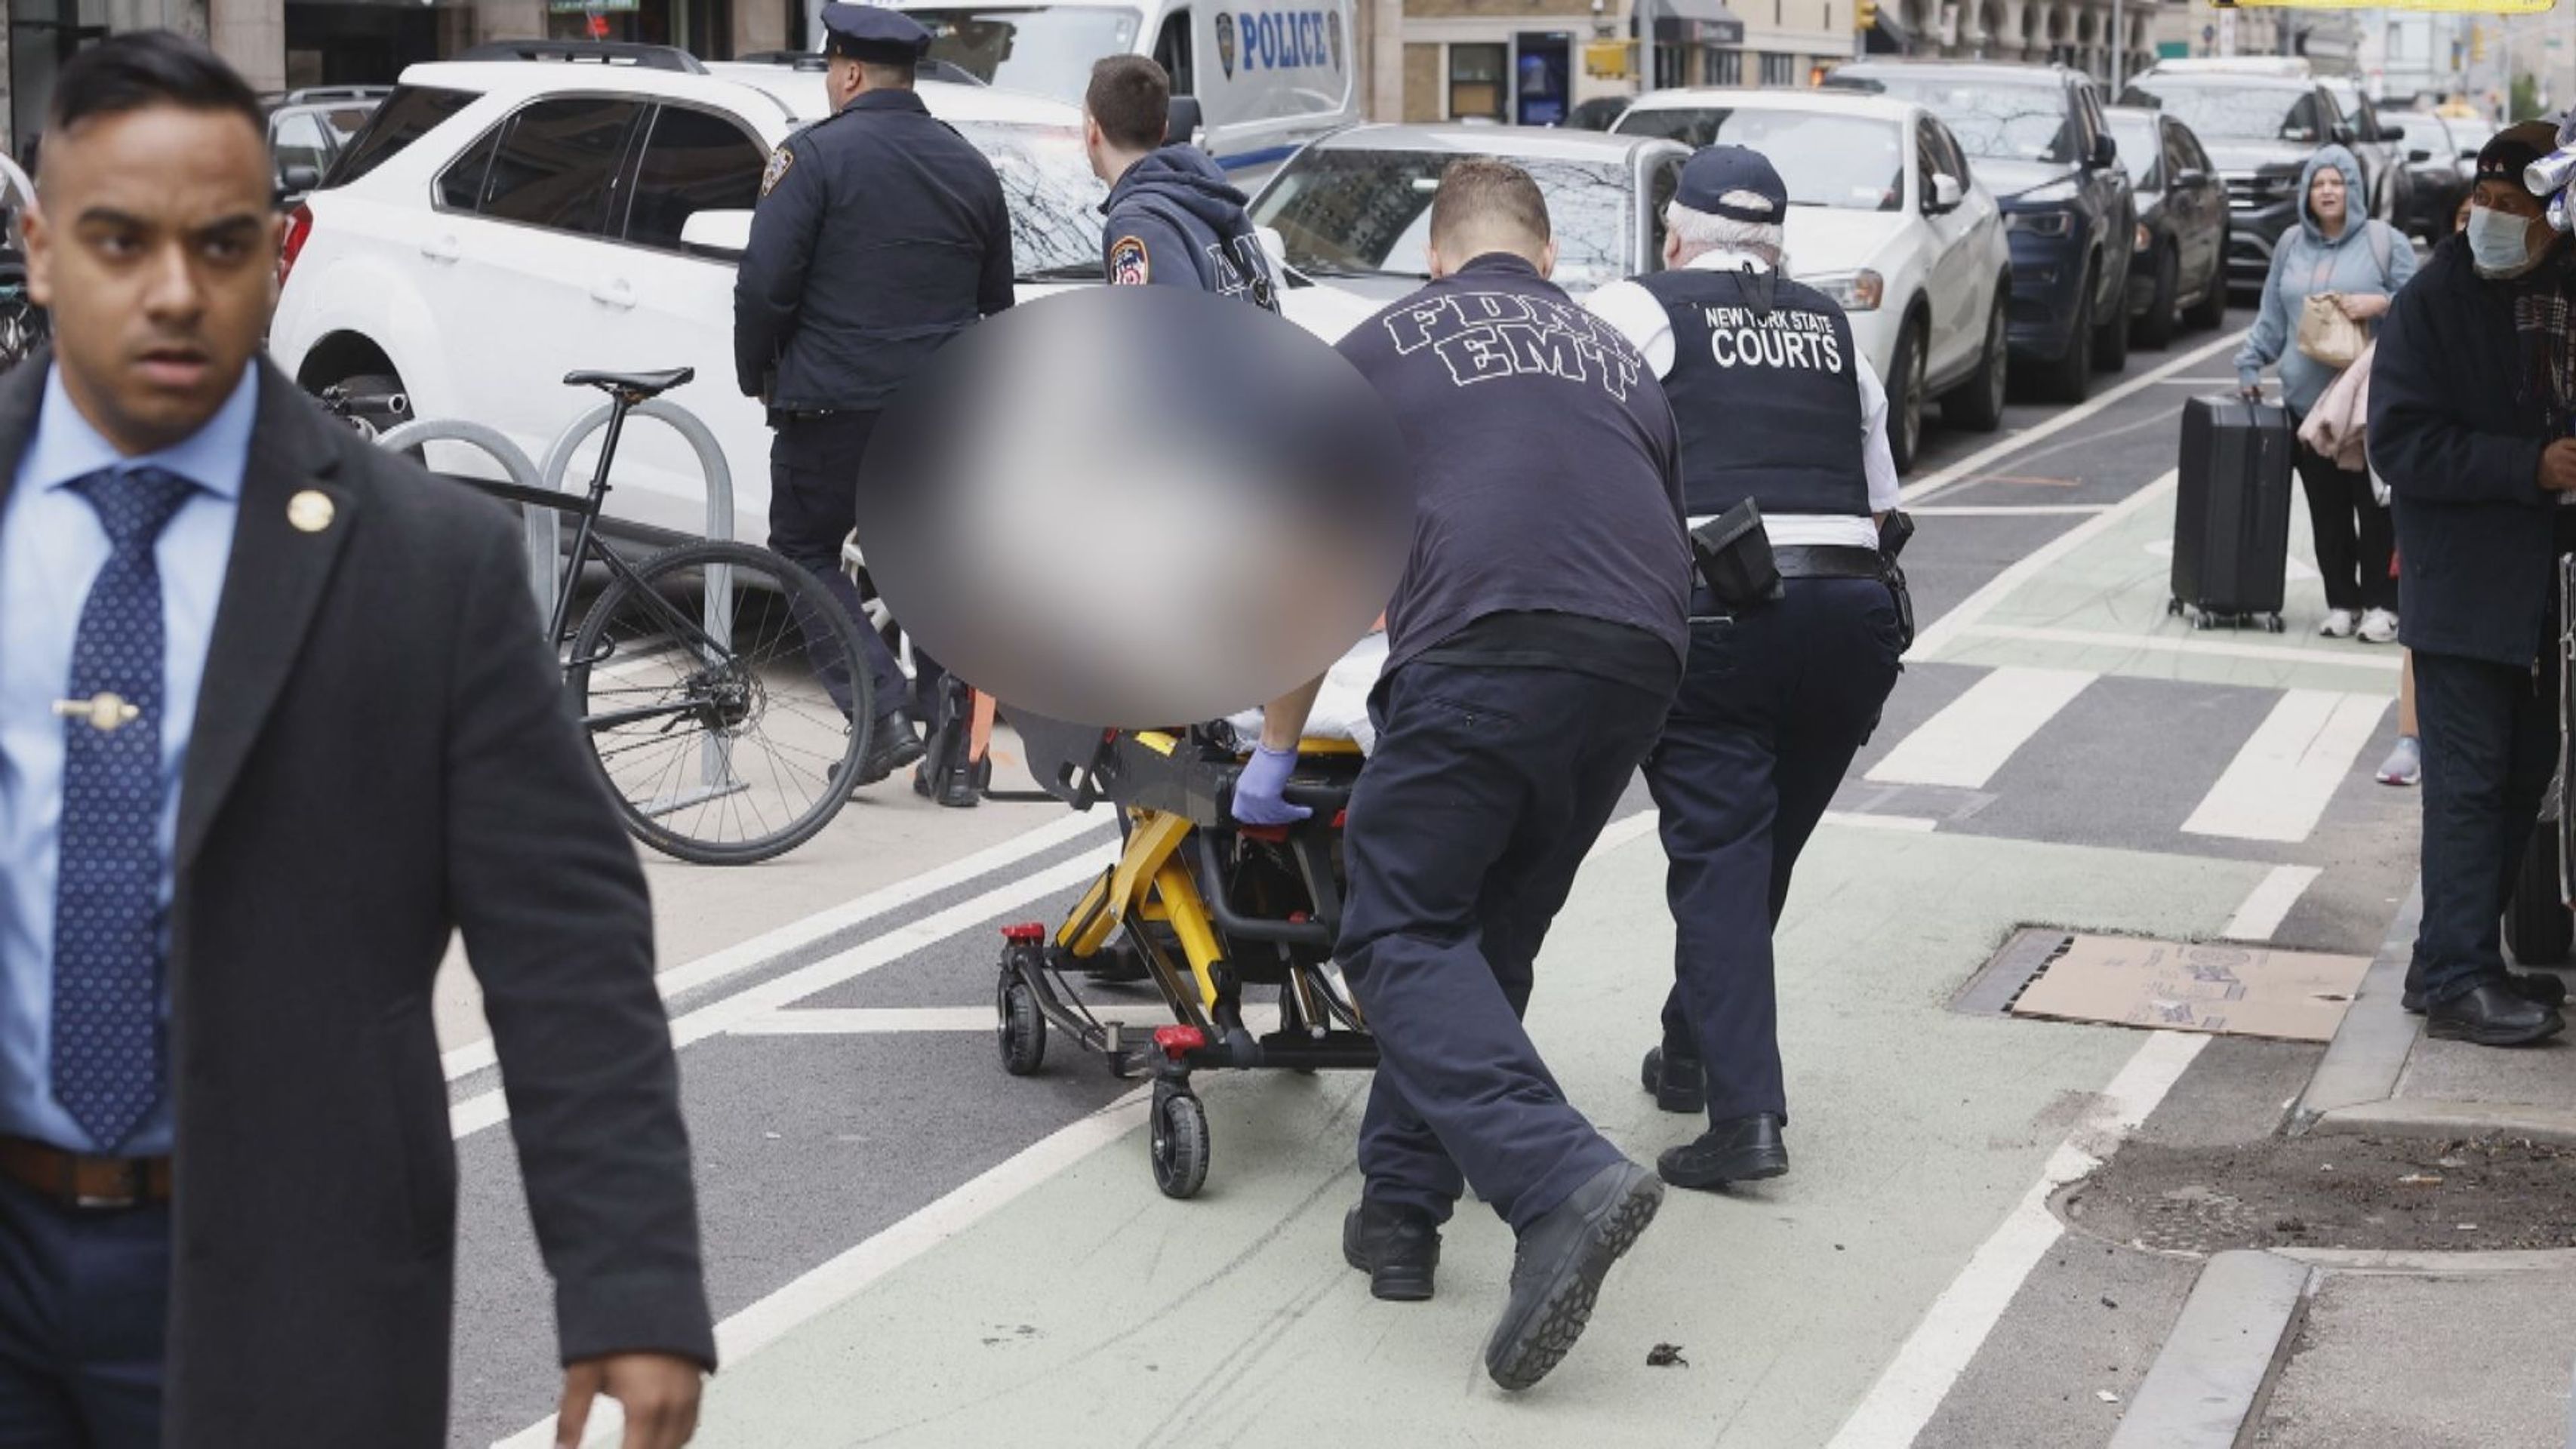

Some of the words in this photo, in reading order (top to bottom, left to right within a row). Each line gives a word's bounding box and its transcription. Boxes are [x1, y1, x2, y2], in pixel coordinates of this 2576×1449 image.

[1239, 11, 1327, 70] POLICE
[1705, 307, 1743, 328] NEW
[1790, 310, 1835, 334] STATE
[1434, 323, 1639, 402] EMT
[1711, 327, 1842, 374] COURTS
